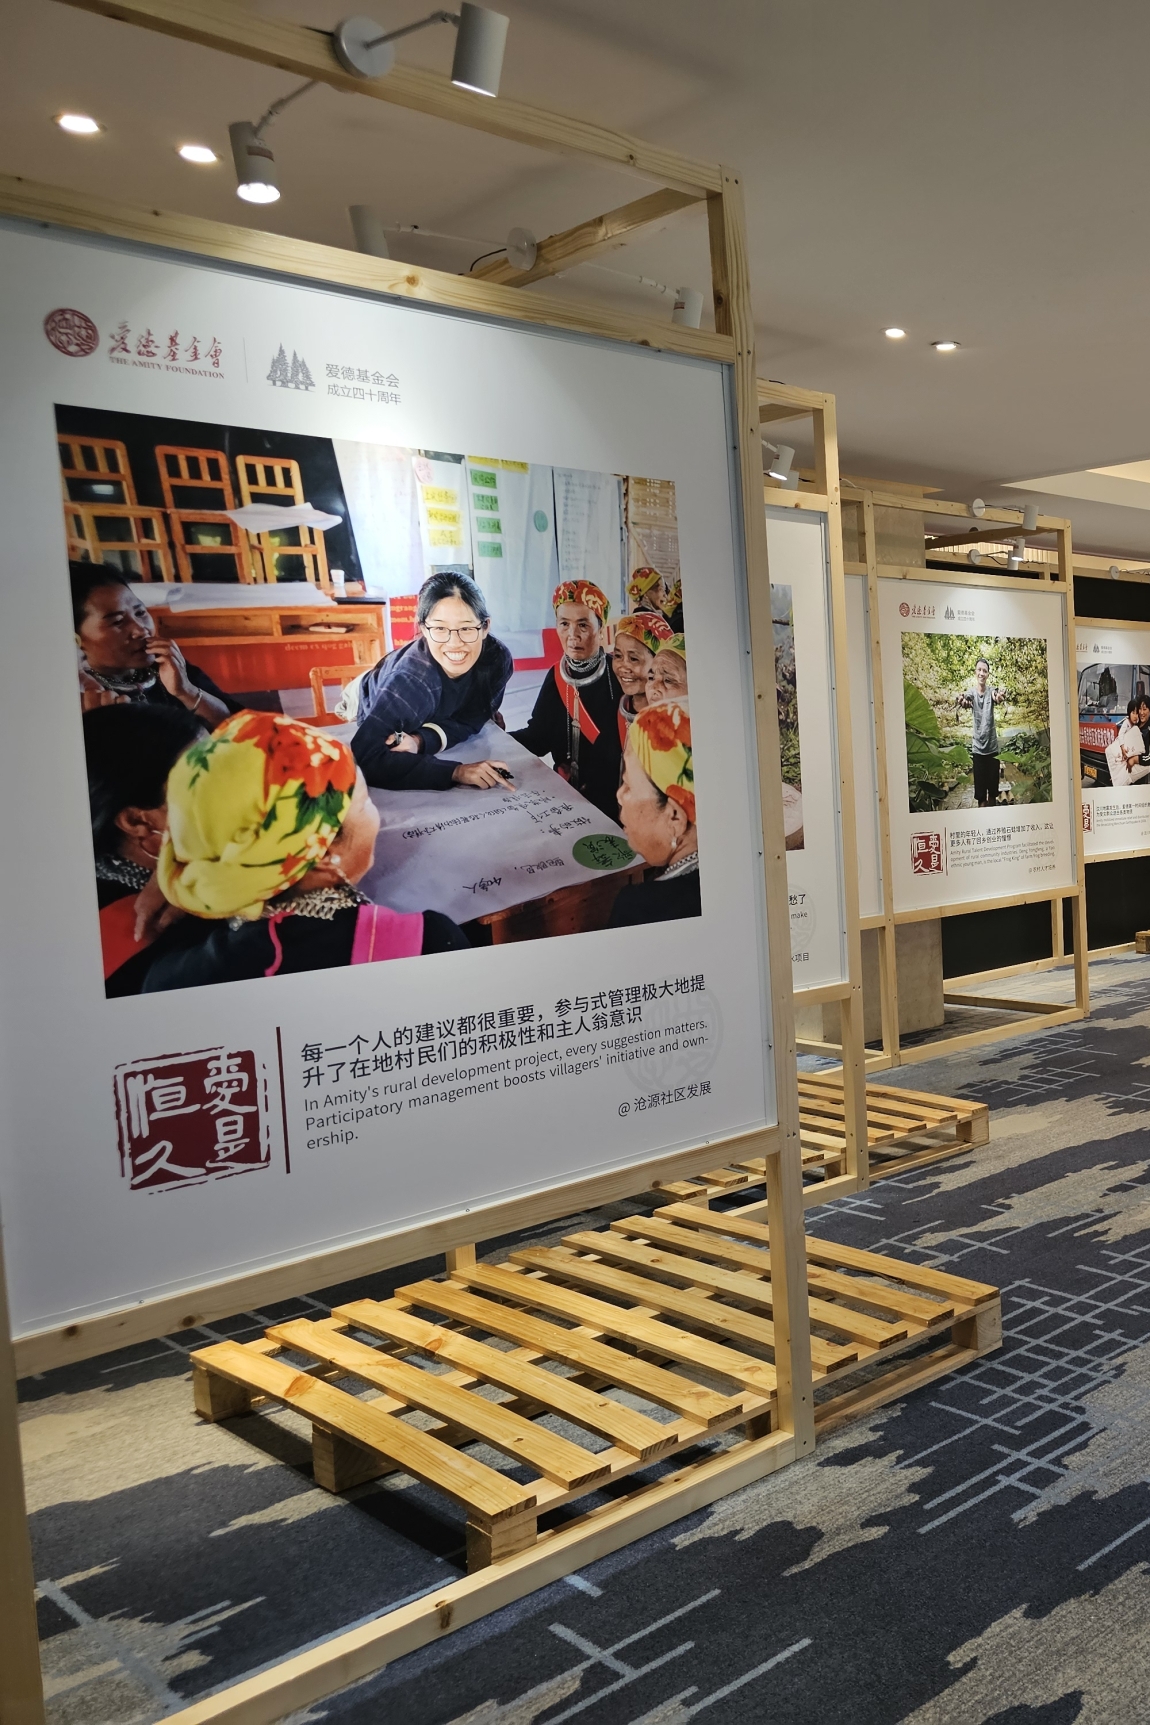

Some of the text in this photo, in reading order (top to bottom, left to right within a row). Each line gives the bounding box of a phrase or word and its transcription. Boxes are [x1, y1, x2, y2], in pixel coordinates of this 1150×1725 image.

[109, 357, 225, 379] THE AMITY FOUNDATION
[325, 363, 400, 388] 爱德基金会
[327, 383, 401, 405] 成立四十周年
[301, 974, 706, 1063] 每一个人的建议都很重要，参与式管理极大地提
[302, 1006, 643, 1089] 升了在地村民们的积极性和主人翁意识
[304, 1019, 708, 1112] In Amity's rural development project, every suggestion matters.
[306, 1035, 709, 1131] Participatory management boosts villagers' initiative and own-
[617, 1080, 712, 1117] @ 沧源社区发展
[306, 1129, 358, 1150] ership.
